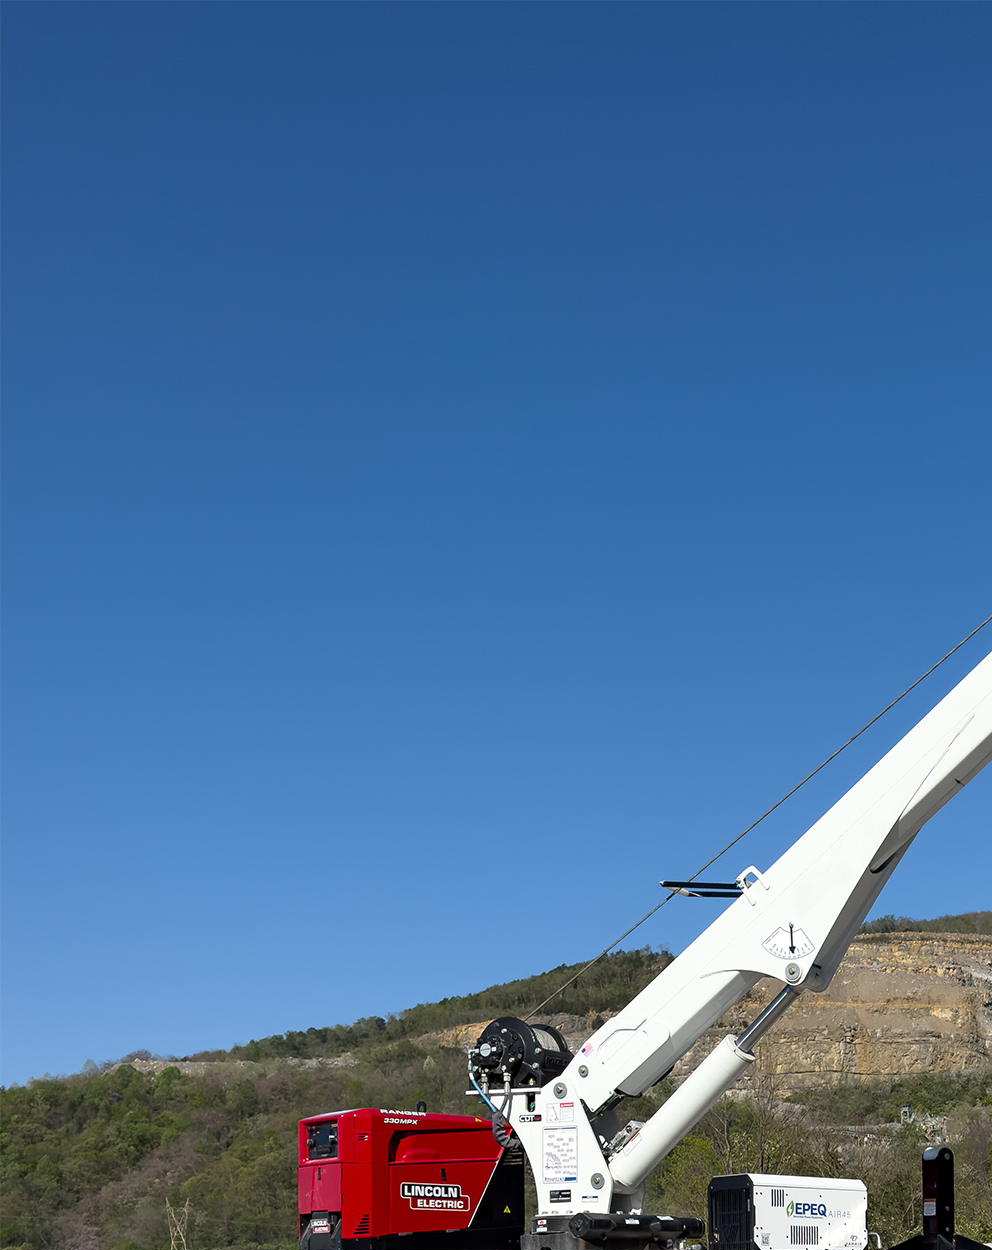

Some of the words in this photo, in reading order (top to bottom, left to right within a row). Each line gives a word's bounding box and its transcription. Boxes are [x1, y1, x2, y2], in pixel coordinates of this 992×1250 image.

[380, 1108, 427, 1117] RANGER
[383, 1117, 418, 1125] 330MPX
[404, 1184, 458, 1198] LINCOLN
[417, 1198, 464, 1209] ELECTRIC
[795, 1202, 827, 1217] EPEQ
[828, 1210, 851, 1219] AIR45
